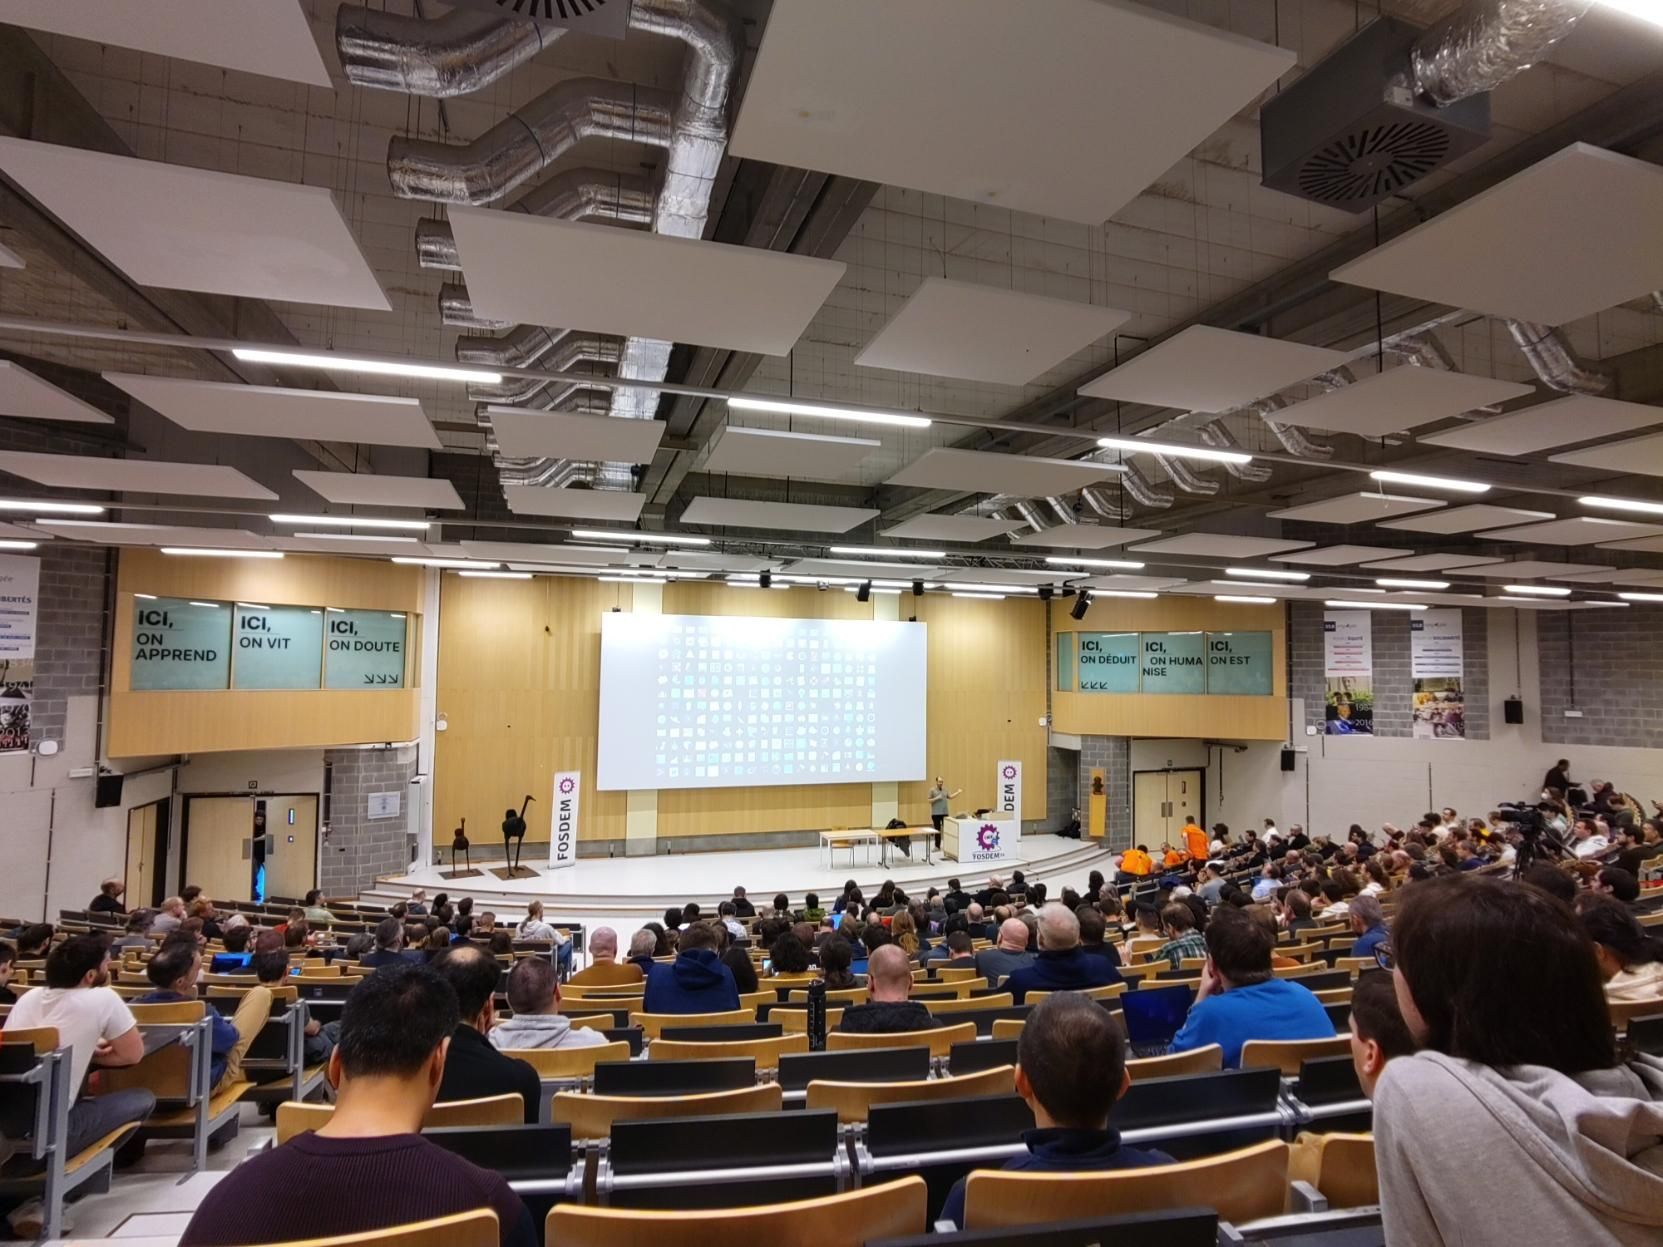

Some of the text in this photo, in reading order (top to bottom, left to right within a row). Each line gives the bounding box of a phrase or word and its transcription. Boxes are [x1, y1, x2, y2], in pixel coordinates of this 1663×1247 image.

[138, 610, 173, 629] ICI,
[241, 615, 271, 632] ICI,
[331, 620, 358, 636] ICI,
[136, 633, 163, 646] ON
[239, 637, 291, 649] ON VIT
[329, 640, 400, 653] ON DOUTE
[1082, 641, 1102, 653] ICI,
[1145, 641, 1167, 653] ICI,
[1210, 641, 1232, 653] ICI,
[135, 649, 217, 662] APPREND
[1081, 653, 1137, 664] ON DÉDUIT
[1150, 656, 1203, 666] ON HUMA
[1210, 656, 1251, 665] ON EST
[1143, 668, 1167, 677] NISE
[1004, 783, 1015, 811] DEM
[557, 799, 572, 861] FOSDEM
